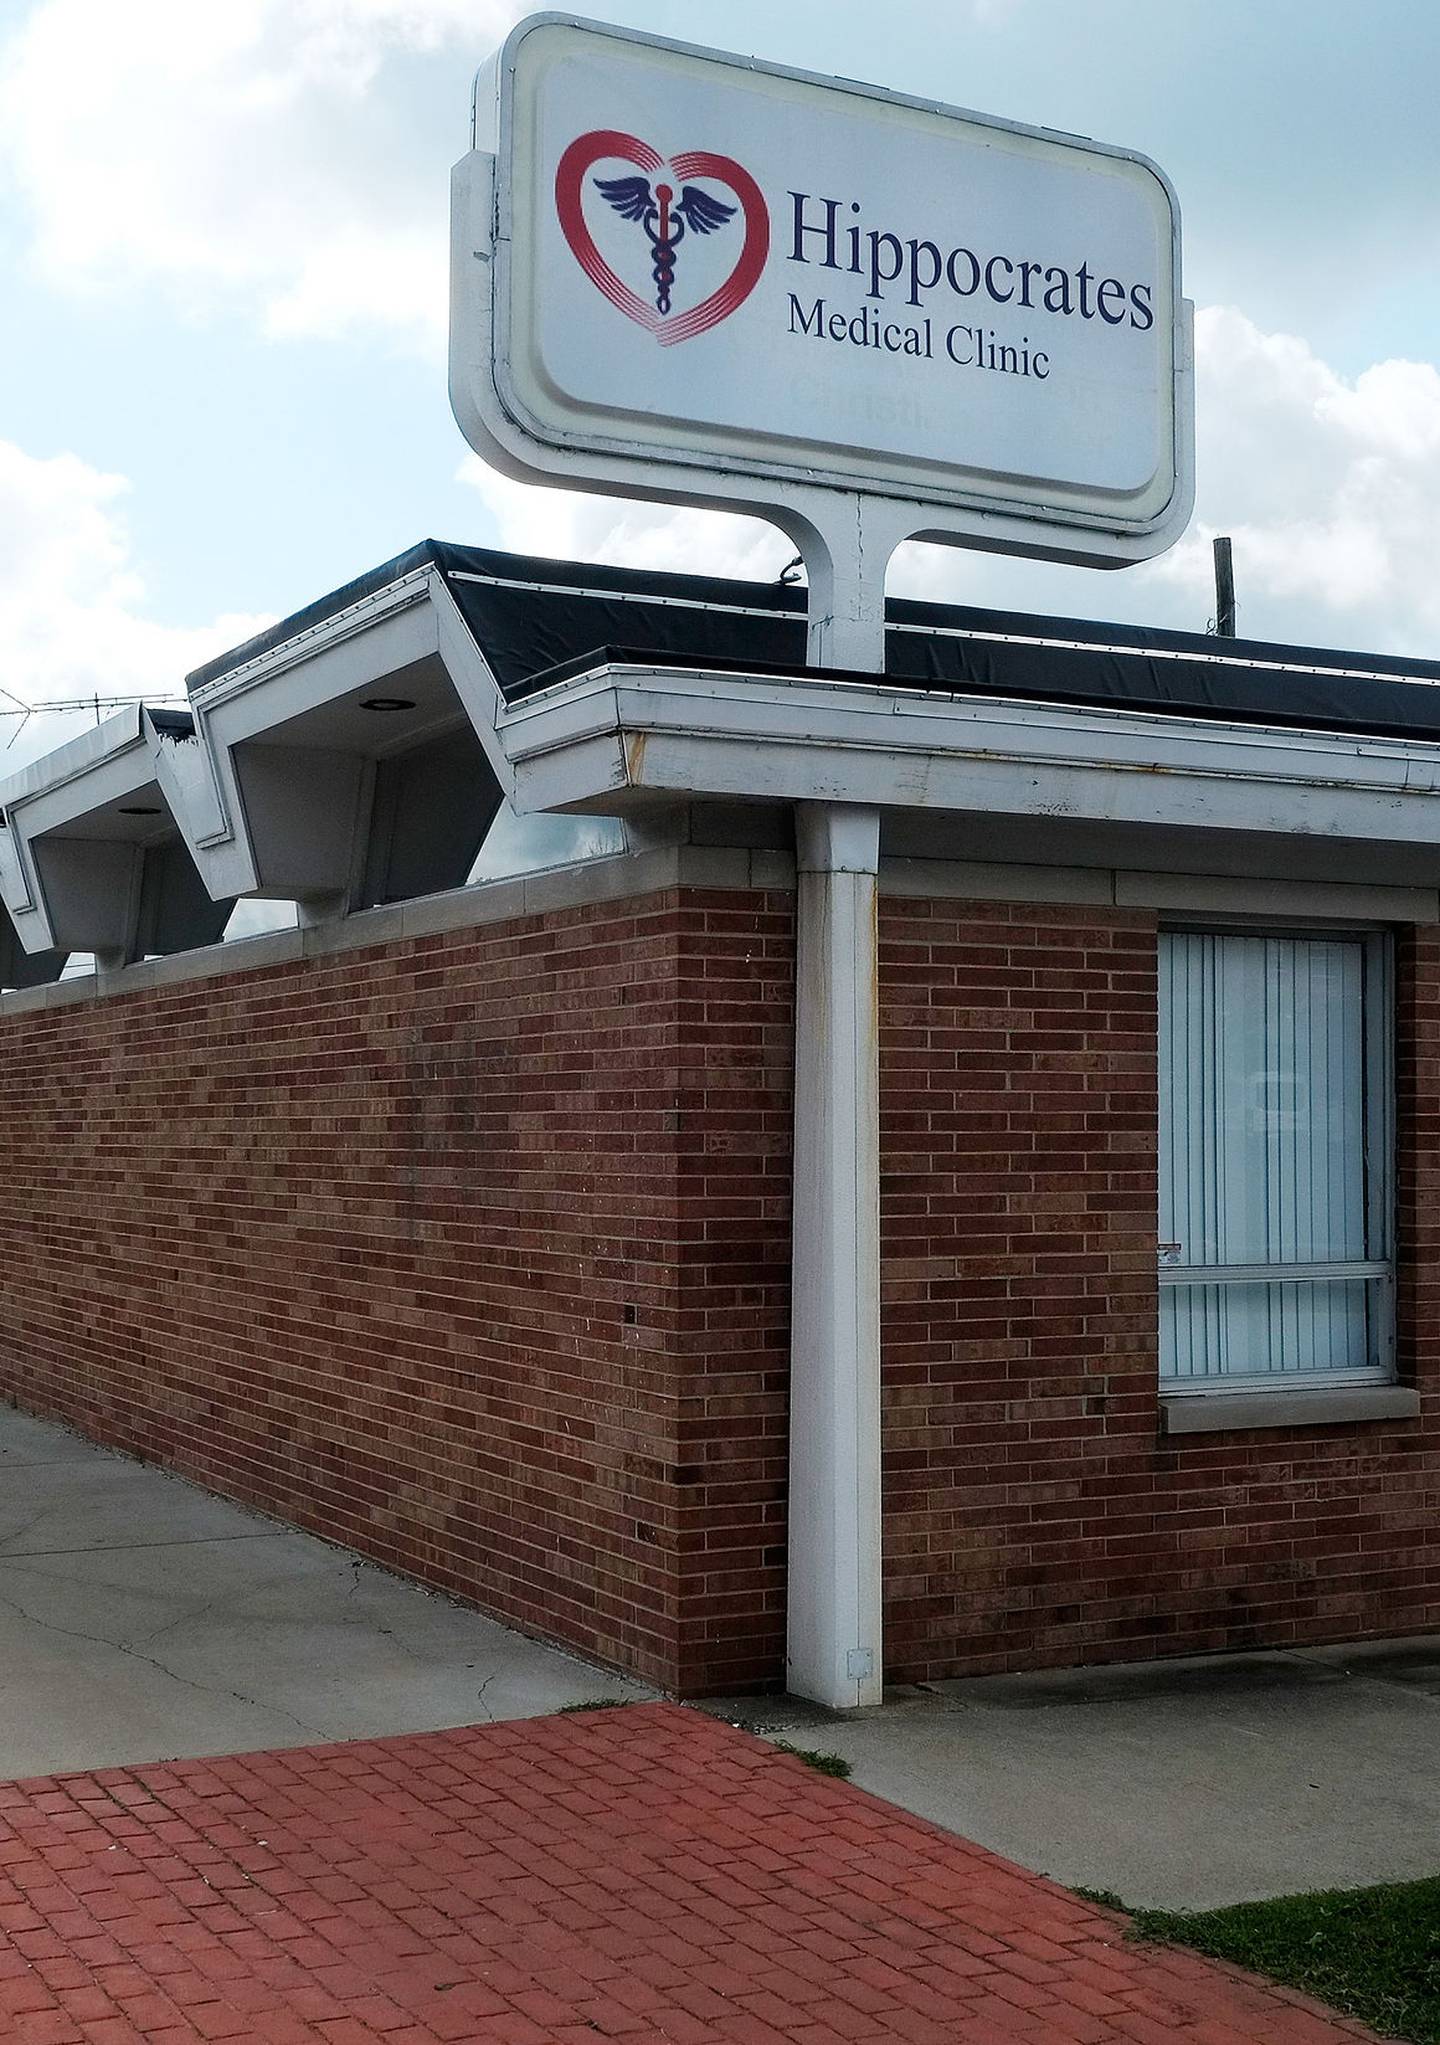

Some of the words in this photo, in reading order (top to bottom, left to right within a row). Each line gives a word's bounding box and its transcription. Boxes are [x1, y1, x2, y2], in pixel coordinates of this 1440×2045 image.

[786, 190, 1154, 331] Hippocrates
[787, 292, 934, 359] Medical
[946, 325, 1050, 380] Clinic
